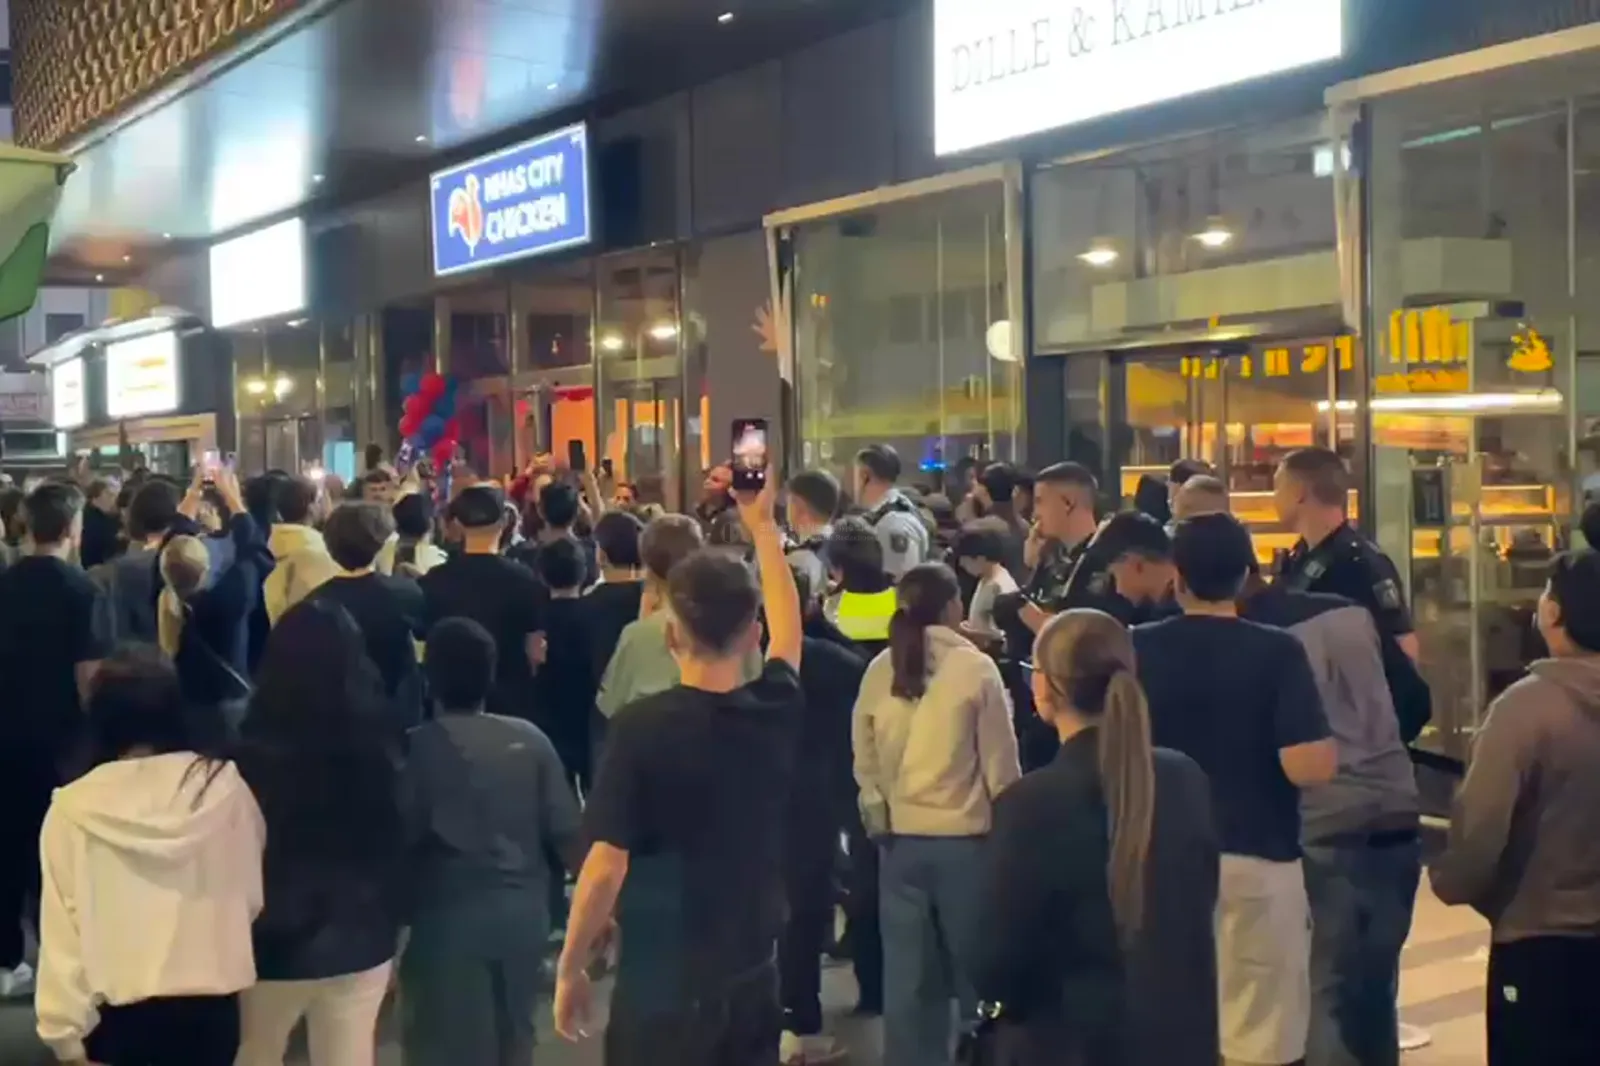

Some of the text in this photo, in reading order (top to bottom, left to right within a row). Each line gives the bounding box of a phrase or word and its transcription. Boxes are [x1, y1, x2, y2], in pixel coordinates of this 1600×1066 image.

[951, 18, 1051, 93] DILLE
[1068, 7, 1096, 57] &
[528, 152, 565, 189] CITY
[486, 193, 567, 244] CHICKEN
